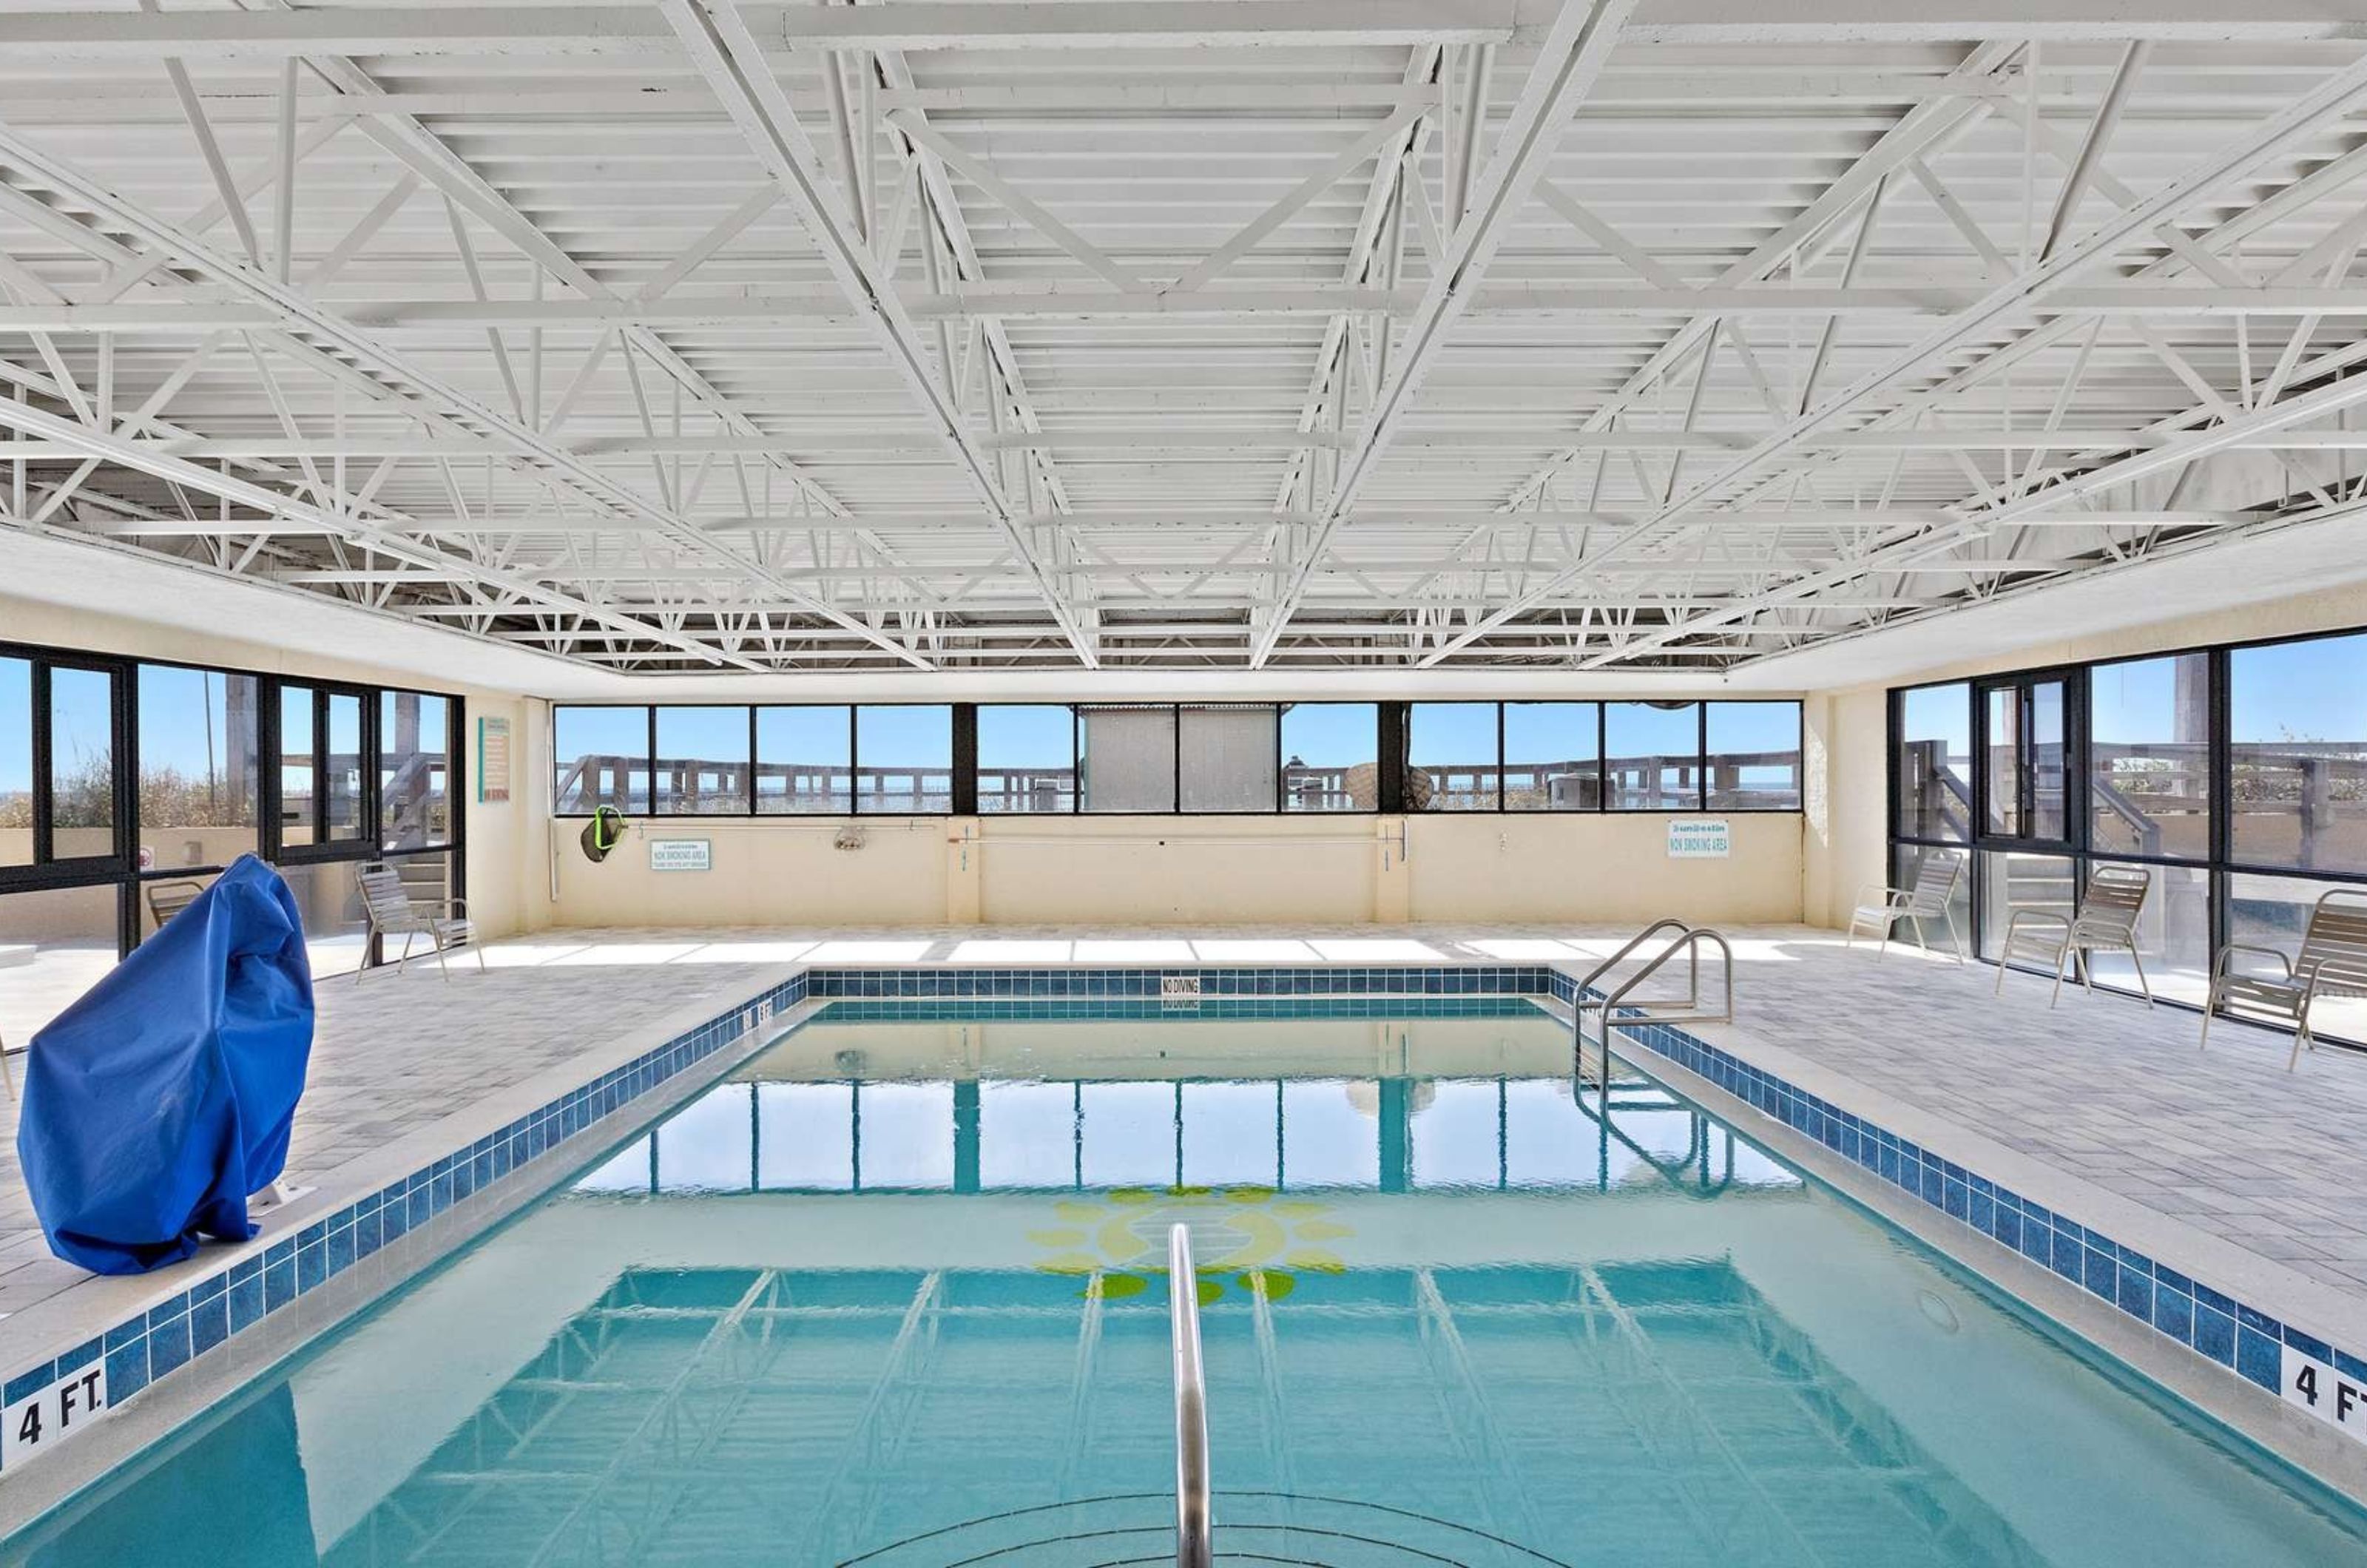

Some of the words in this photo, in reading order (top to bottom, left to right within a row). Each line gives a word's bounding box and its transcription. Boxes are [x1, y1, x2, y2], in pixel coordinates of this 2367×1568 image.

[1670, 838, 1682, 851] NON
[1684, 838, 1711, 851] SMOKING
[1712, 838, 1727, 851] AREA
[1164, 979, 1172, 993] NO
[1174, 979, 1198, 993] DIVING
[2296, 1365, 2318, 1407] 4
[19, 1402, 42, 1444] 4
[61, 1369, 102, 1428] FT.
